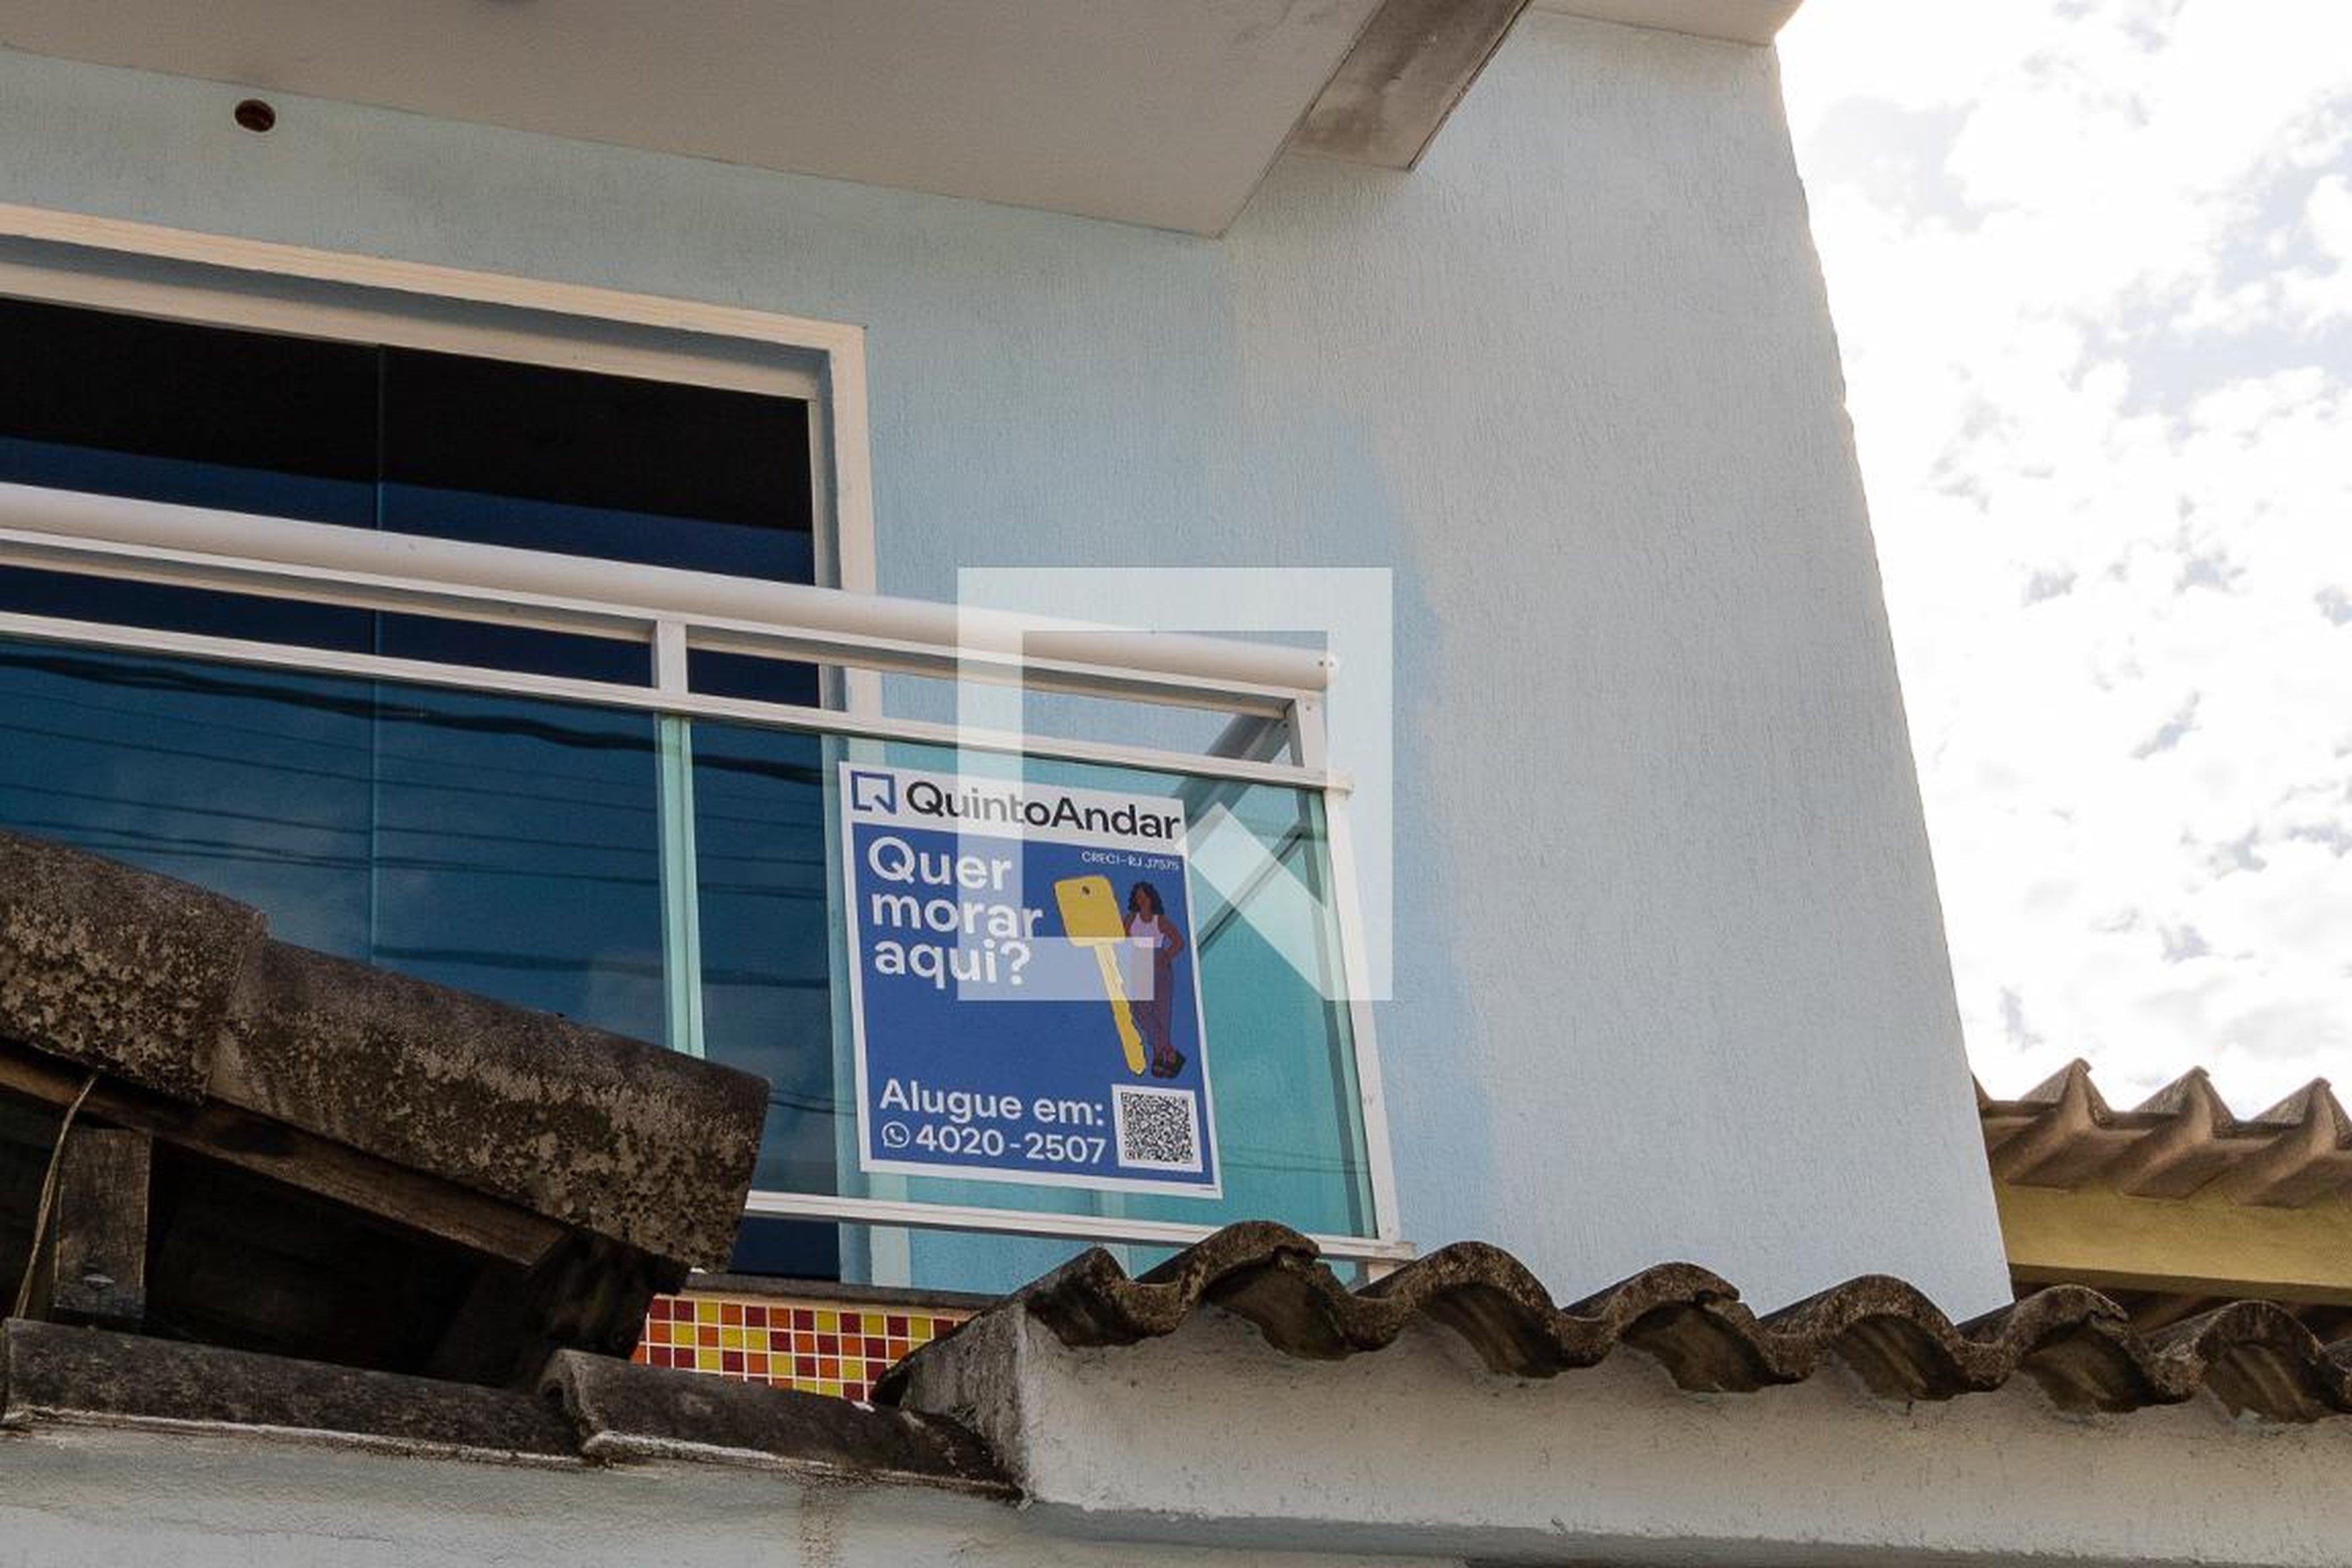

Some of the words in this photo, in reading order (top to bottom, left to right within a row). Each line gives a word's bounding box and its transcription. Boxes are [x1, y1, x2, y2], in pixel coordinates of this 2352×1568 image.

[907, 781, 1181, 839] QuintoAndar
[868, 837, 1012, 890] Quer
[872, 893, 1044, 940] morar
[874, 940, 1031, 989] aqui?
[880, 1078, 1022, 1123] Alugue
[1033, 1100, 1105, 1126] em:
